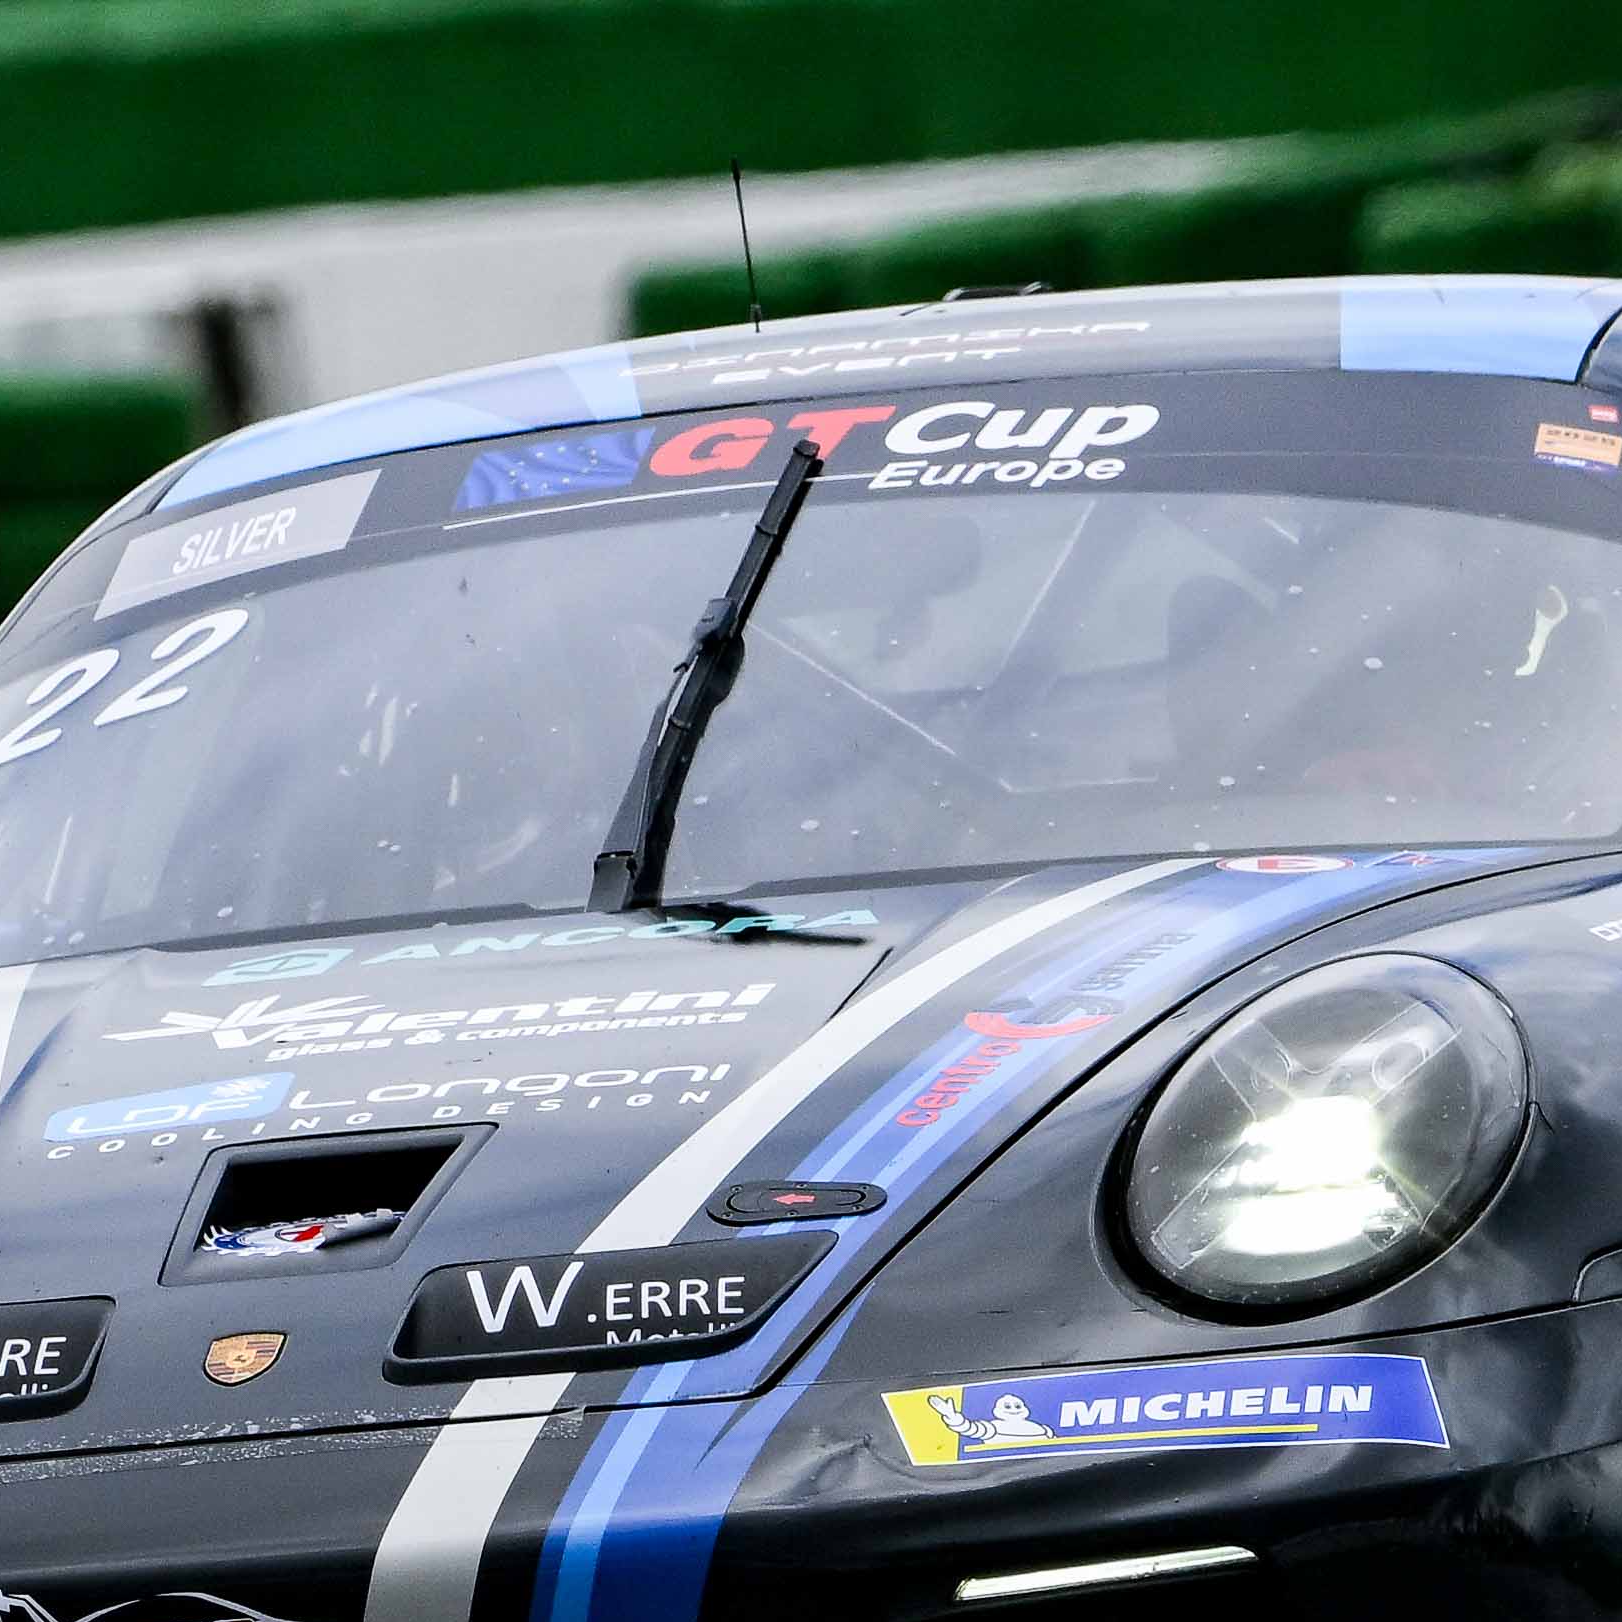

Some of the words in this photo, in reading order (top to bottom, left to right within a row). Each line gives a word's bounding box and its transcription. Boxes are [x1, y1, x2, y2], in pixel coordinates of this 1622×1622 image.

[649, 405, 897, 477] GT
[884, 401, 1160, 459] Cup
[868, 457, 1126, 491] Europe
[172, 505, 298, 577] SILVER
[361, 909, 880, 966] ANCORA
[212, 983, 777, 1050] Valentini
[264, 1037, 394, 1063] glass
[404, 1029, 447, 1046] &
[455, 1011, 749, 1043] components
[289, 1063, 731, 1111] Longoni
[46, 1111, 375, 1161] COOLING
[432, 1089, 713, 1120] DESIGN
[1058, 1384, 1374, 1429] MICHELIN
